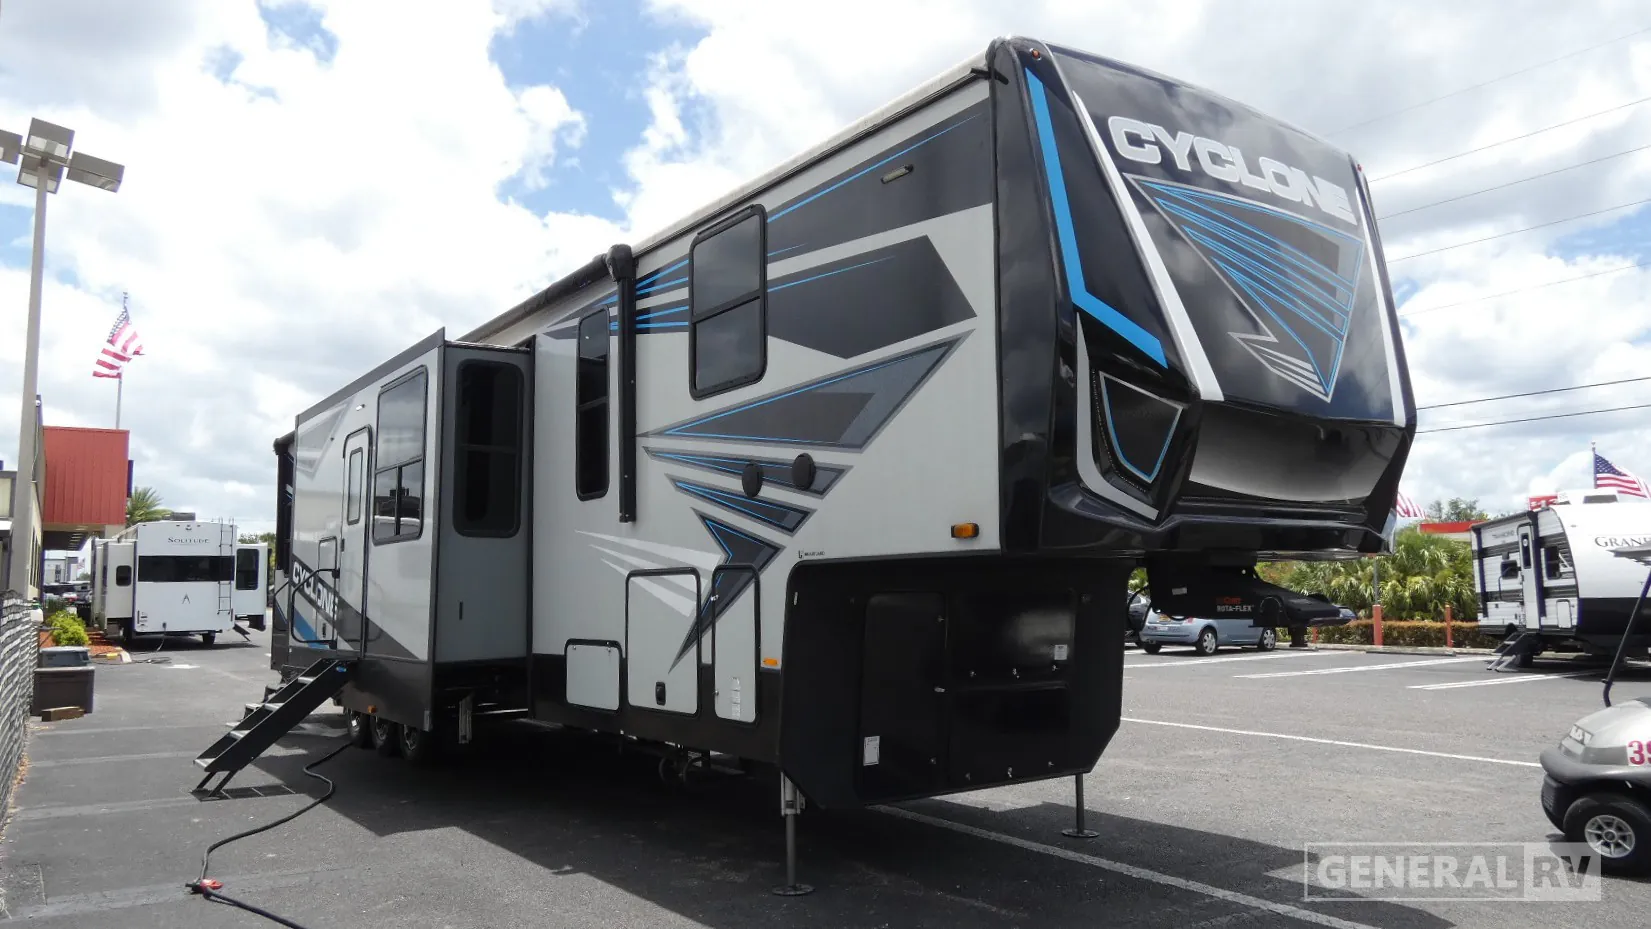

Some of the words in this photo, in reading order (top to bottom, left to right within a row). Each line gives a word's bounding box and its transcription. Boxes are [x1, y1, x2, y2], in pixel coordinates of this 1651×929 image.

[1108, 115, 1358, 226] CYCLONE
[167, 536, 211, 544] SOLITUDE
[292, 561, 339, 621] CYCLONE
[1216, 604, 1252, 612] ROTA-FLEX
